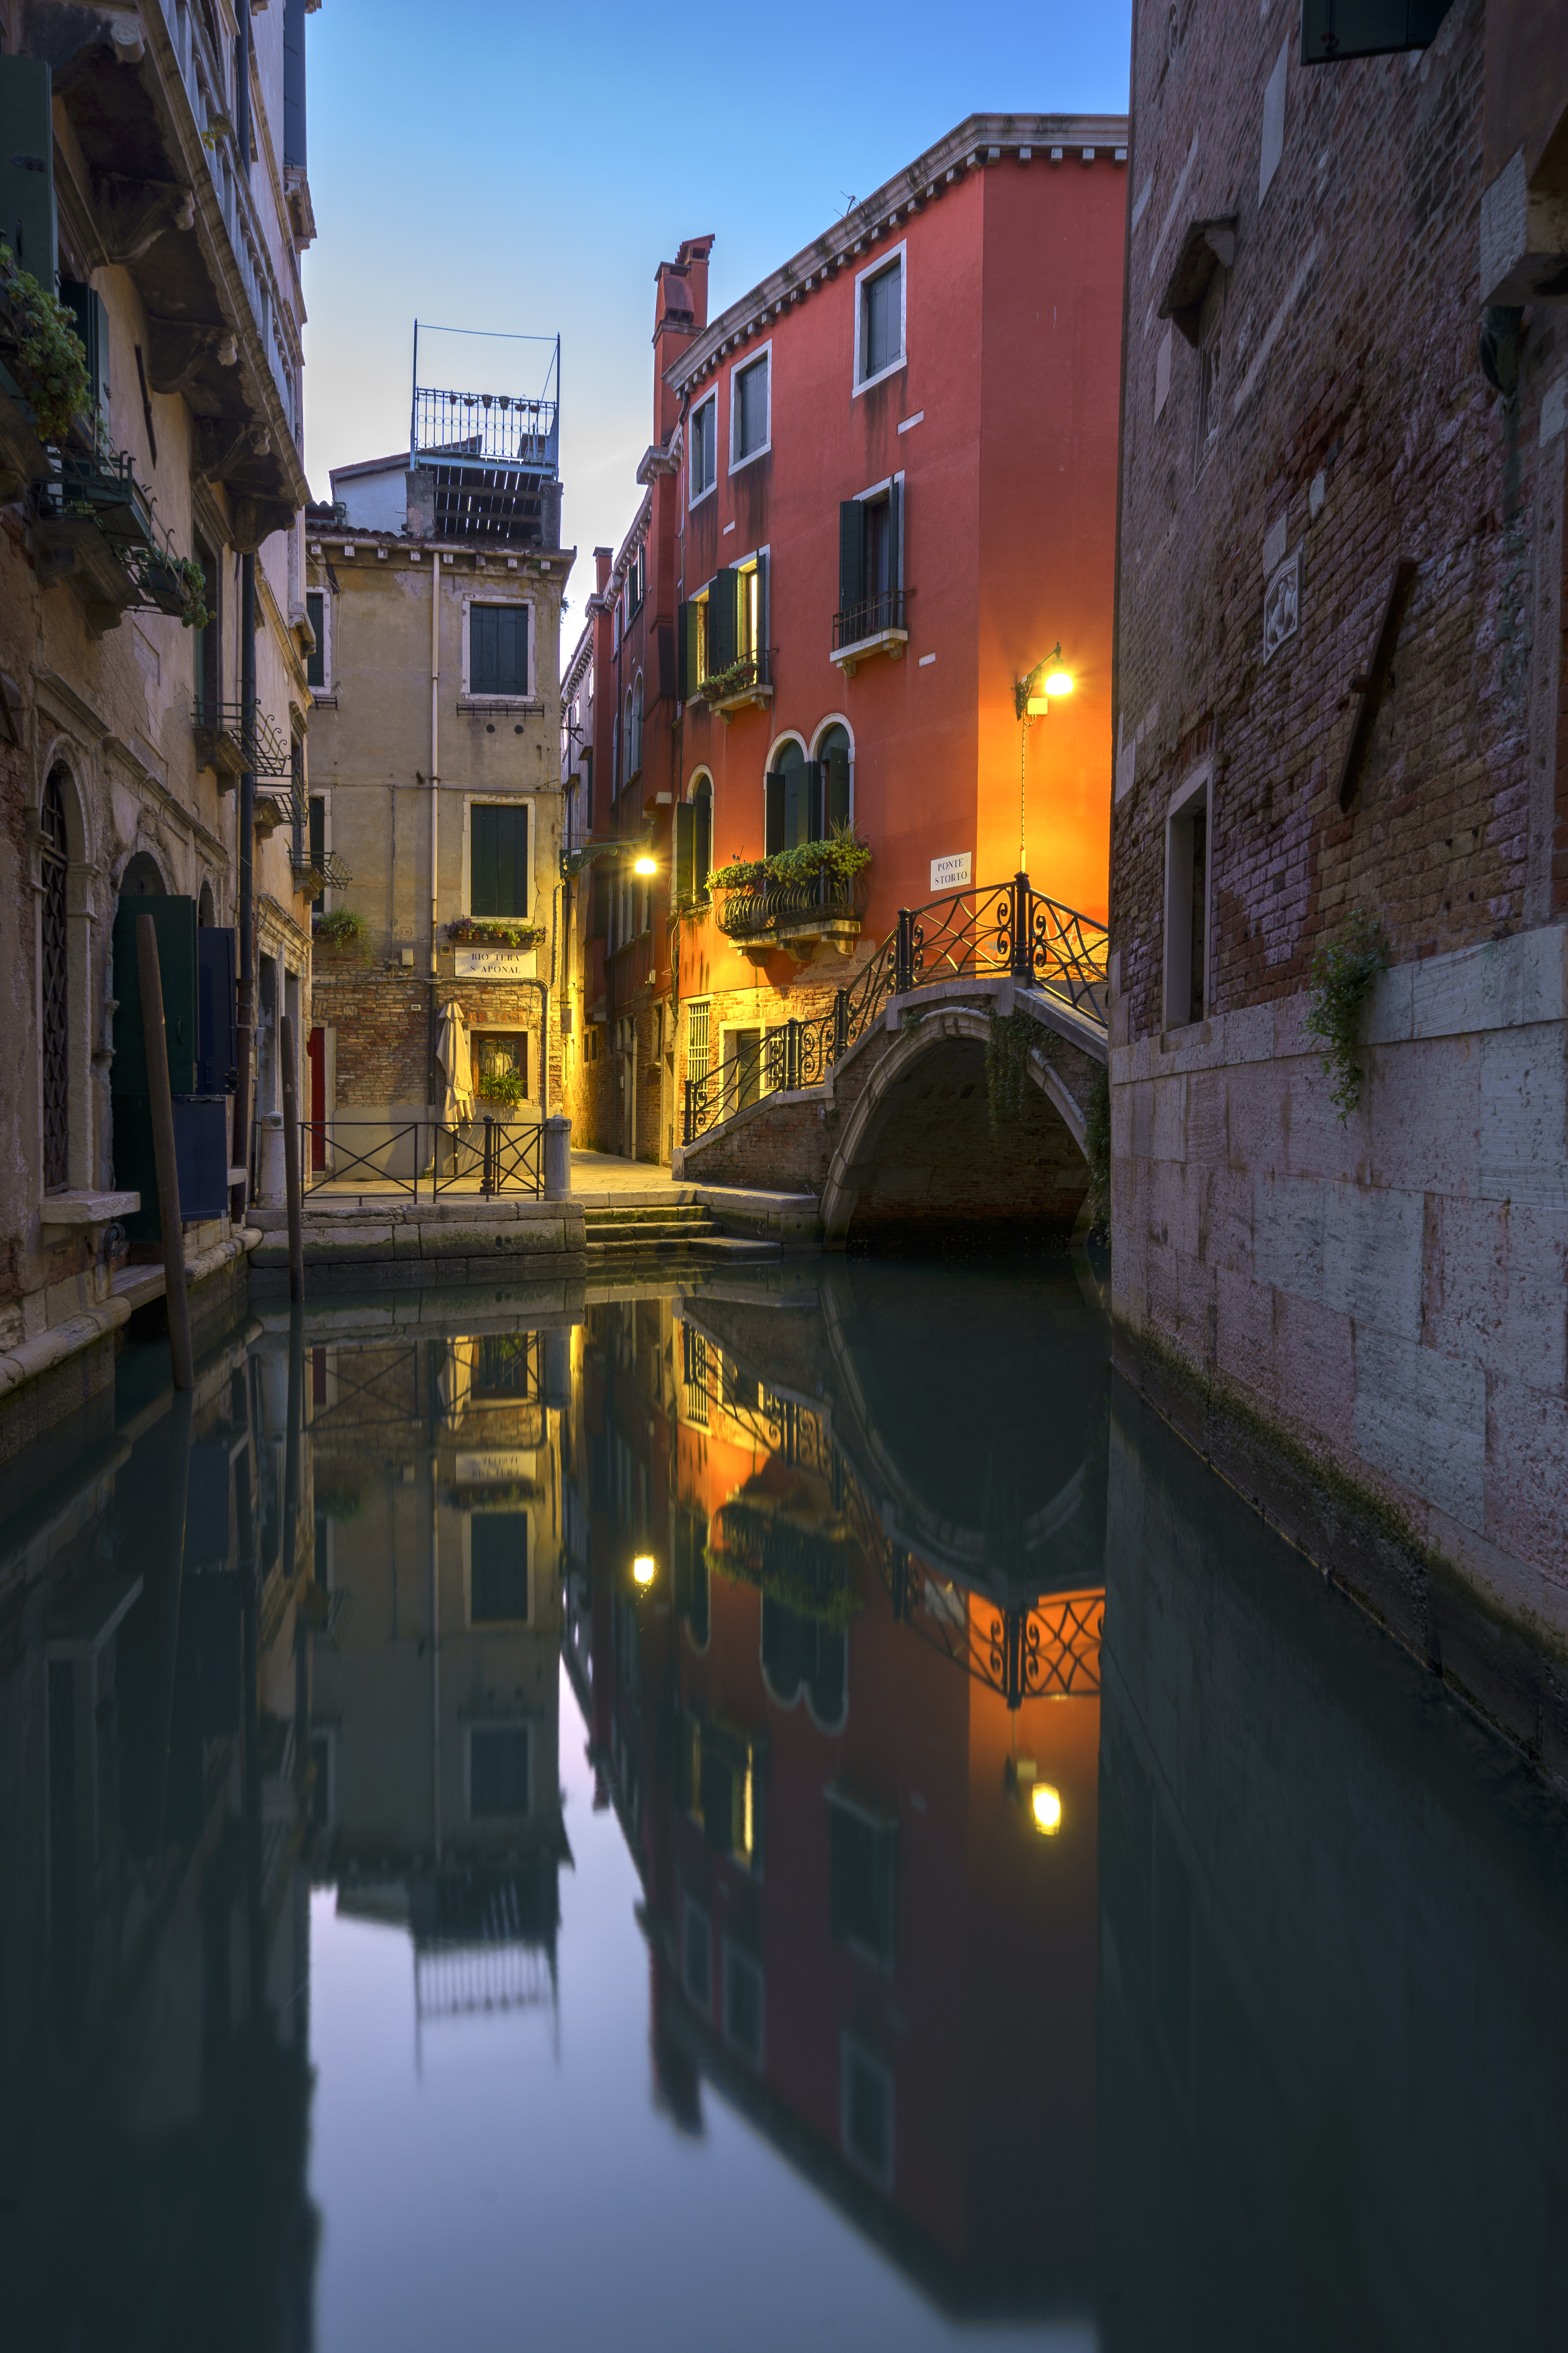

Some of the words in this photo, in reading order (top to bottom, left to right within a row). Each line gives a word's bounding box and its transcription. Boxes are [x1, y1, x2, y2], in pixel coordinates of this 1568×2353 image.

[938, 858, 964, 871] PONTE
[935, 871, 967, 885] STORTO
[481, 965, 521, 973] APONAL
